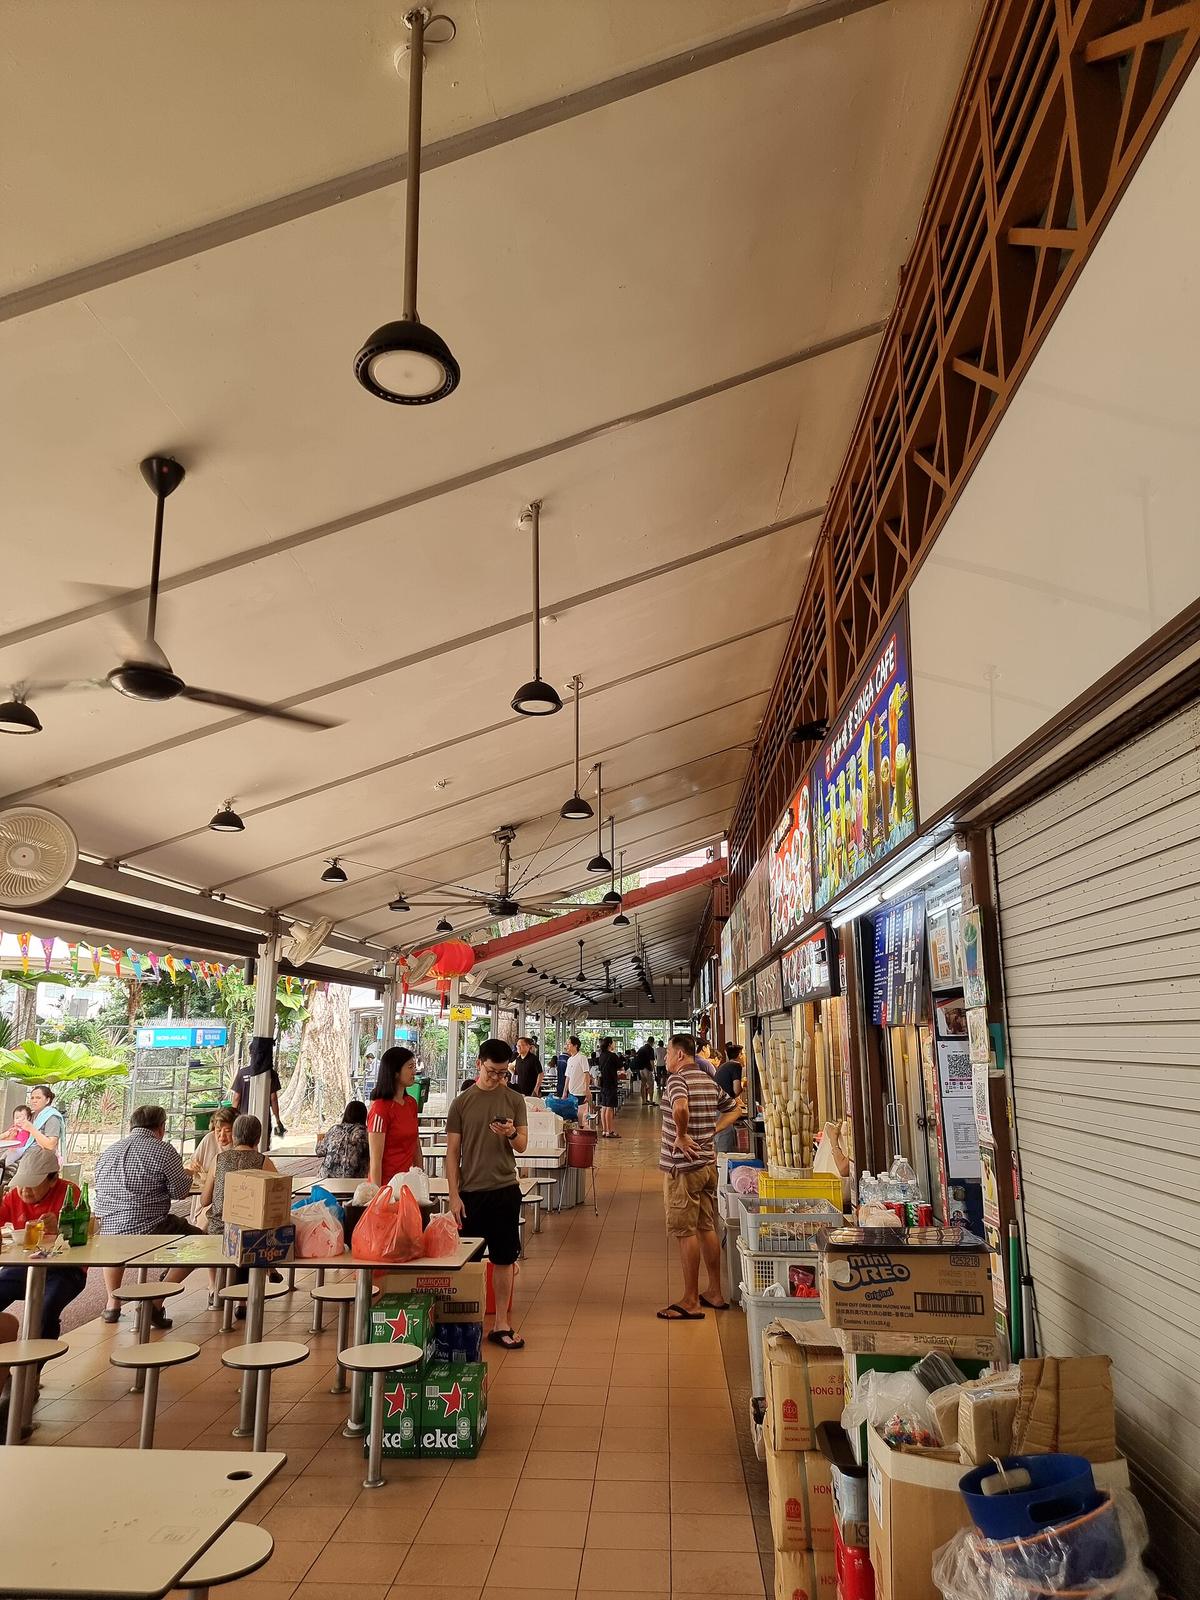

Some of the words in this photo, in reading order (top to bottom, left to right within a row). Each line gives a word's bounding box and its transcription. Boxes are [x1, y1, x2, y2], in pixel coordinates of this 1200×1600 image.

[853, 678, 875, 730] SINGA
[875, 640, 895, 694] CAFE
[258, 1248, 285, 1261] Tiger
[848, 1253, 891, 1266] mini
[417, 1278, 450, 1288] MARIGOLD
[410, 1287, 458, 1295] EVAPORATED
[865, 1287, 894, 1301] Original
[810, 1386, 834, 1396] HONG
[427, 1399, 436, 1408] 12
